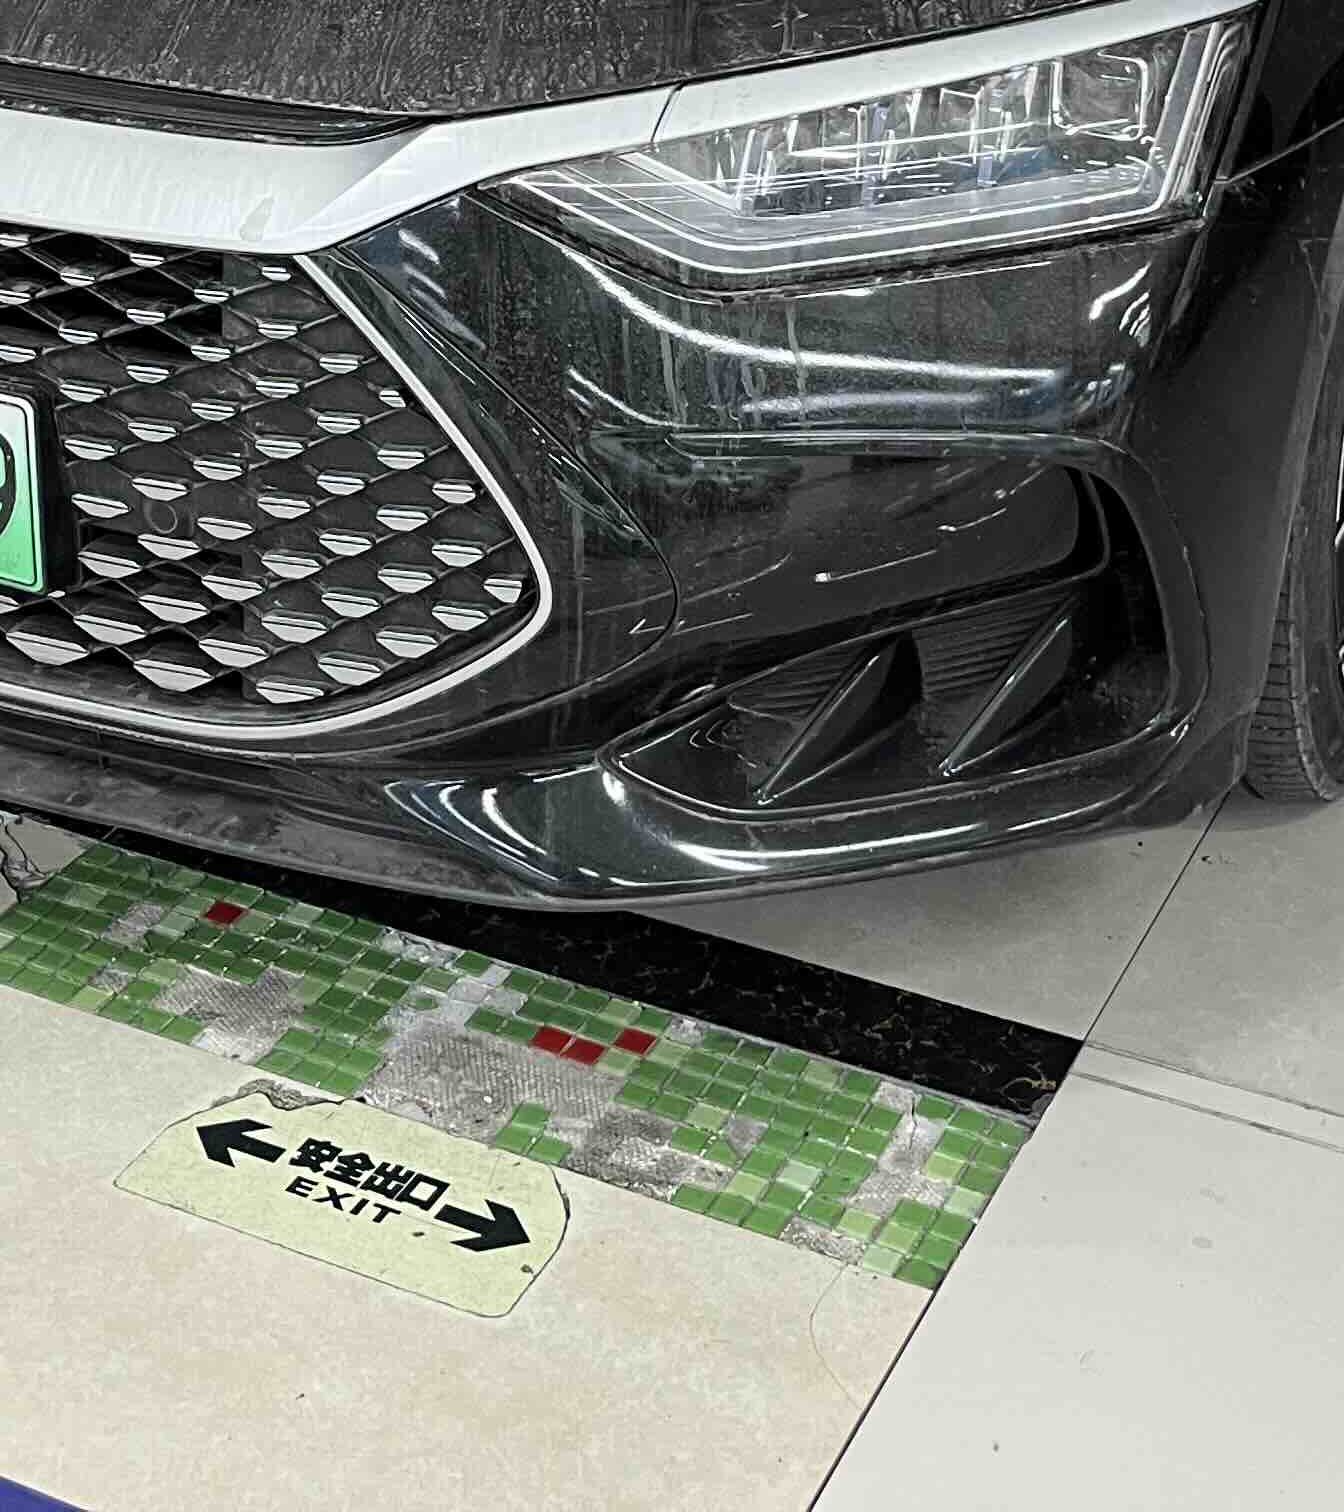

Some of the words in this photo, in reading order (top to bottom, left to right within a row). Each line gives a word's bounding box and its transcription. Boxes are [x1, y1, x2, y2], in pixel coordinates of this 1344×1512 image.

[284, 1175, 405, 1226] EXIT
[288, 1136, 451, 1212] 安全出口
